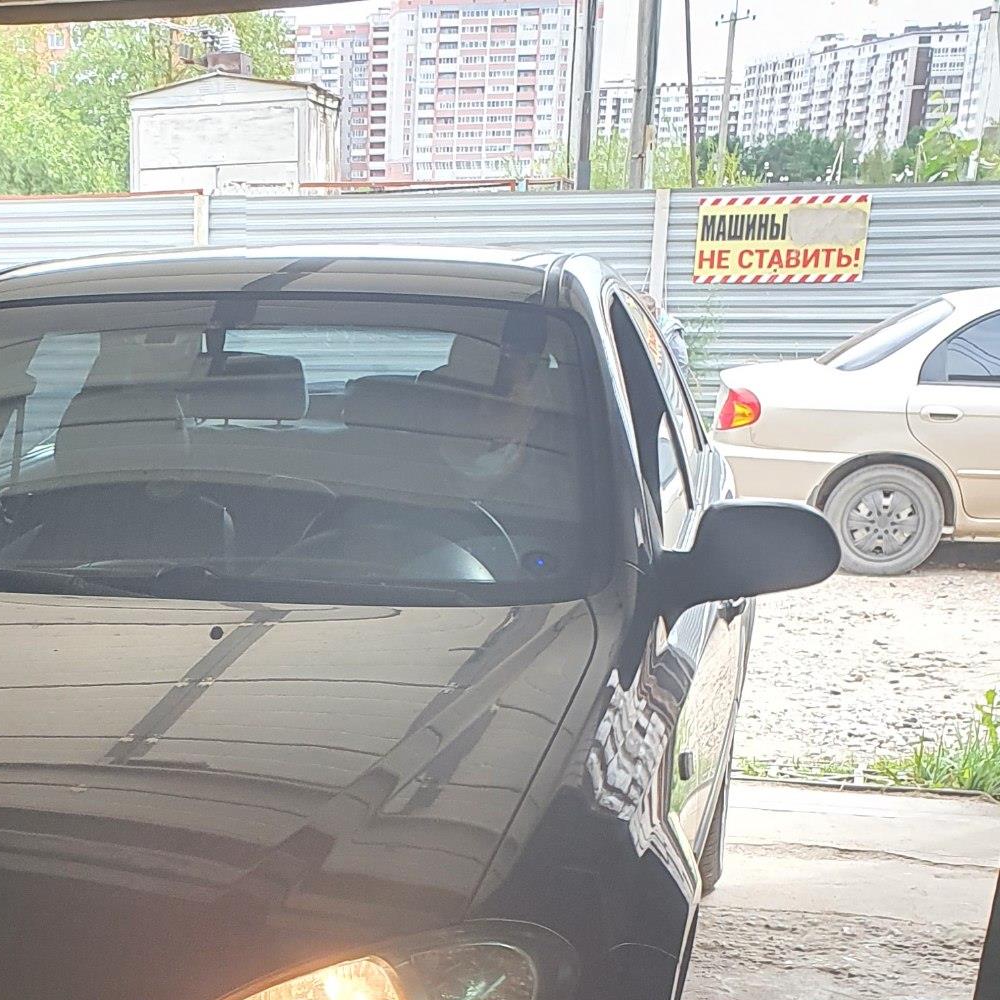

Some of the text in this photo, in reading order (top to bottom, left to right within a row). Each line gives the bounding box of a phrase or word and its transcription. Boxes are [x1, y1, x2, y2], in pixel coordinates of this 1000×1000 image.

[700, 213, 788, 241] МАШИНЫ
[698, 247, 861, 269] НЕ СТАВИТЬ!
